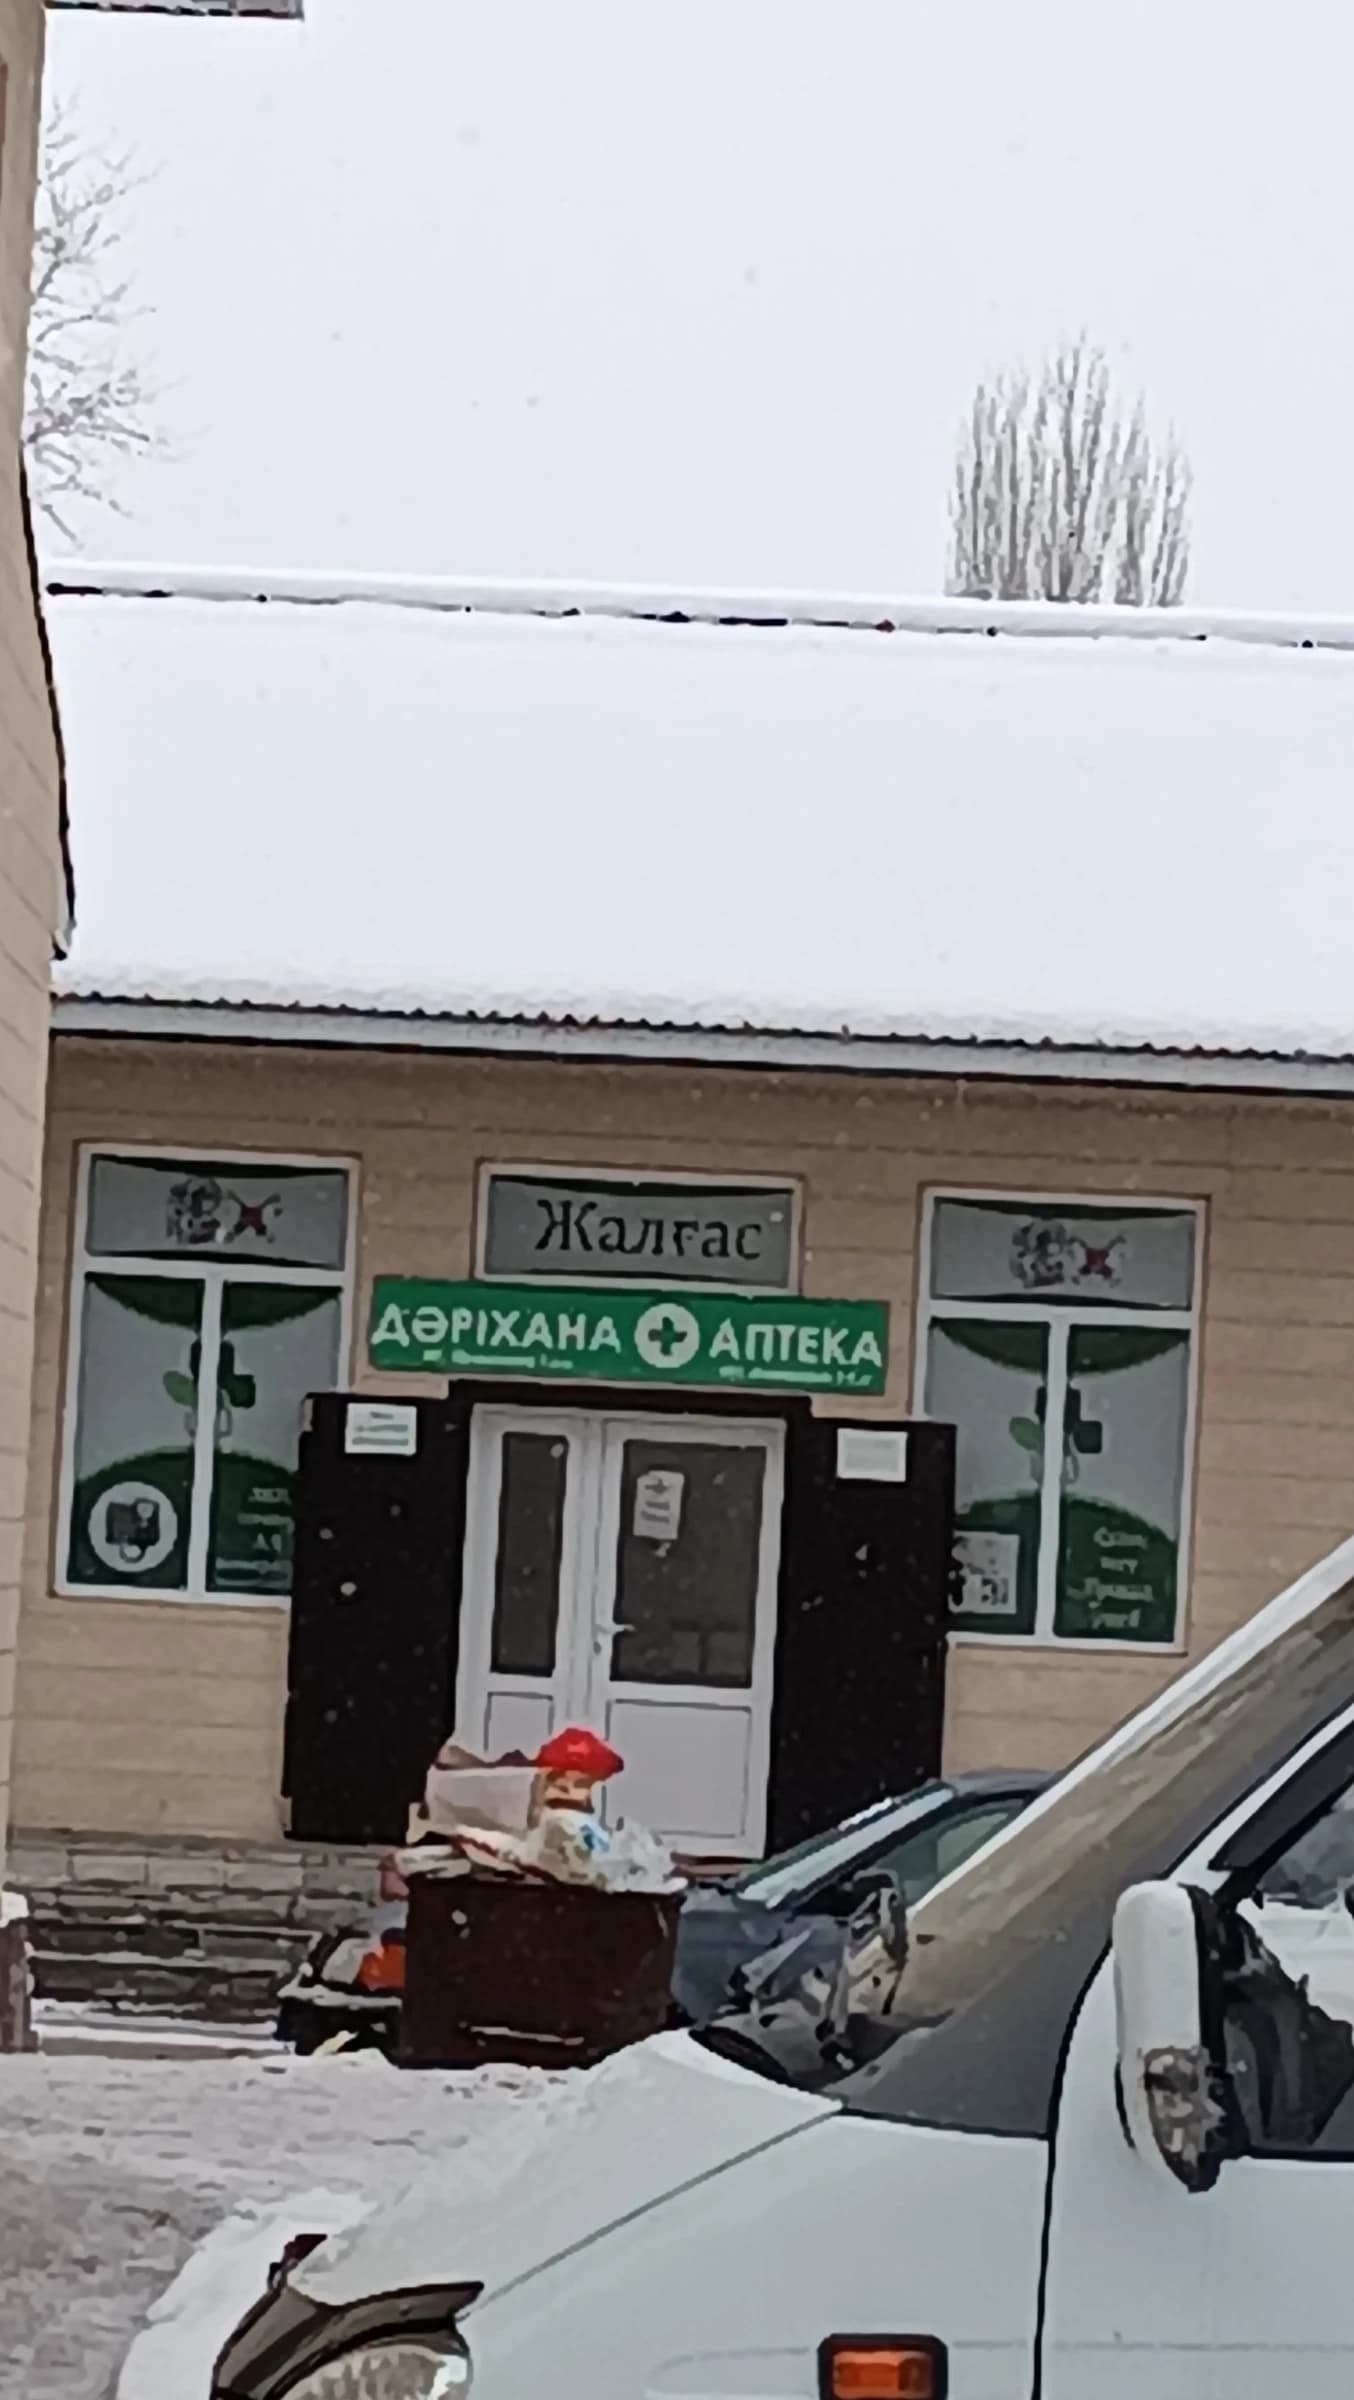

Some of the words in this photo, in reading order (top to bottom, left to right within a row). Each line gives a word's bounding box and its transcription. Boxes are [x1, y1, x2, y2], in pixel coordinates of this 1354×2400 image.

[535, 1199, 763, 1260] Жалғас
[370, 1303, 622, 1354] ДӘРІХАНА
[708, 1317, 883, 1369] АПТЕКА
